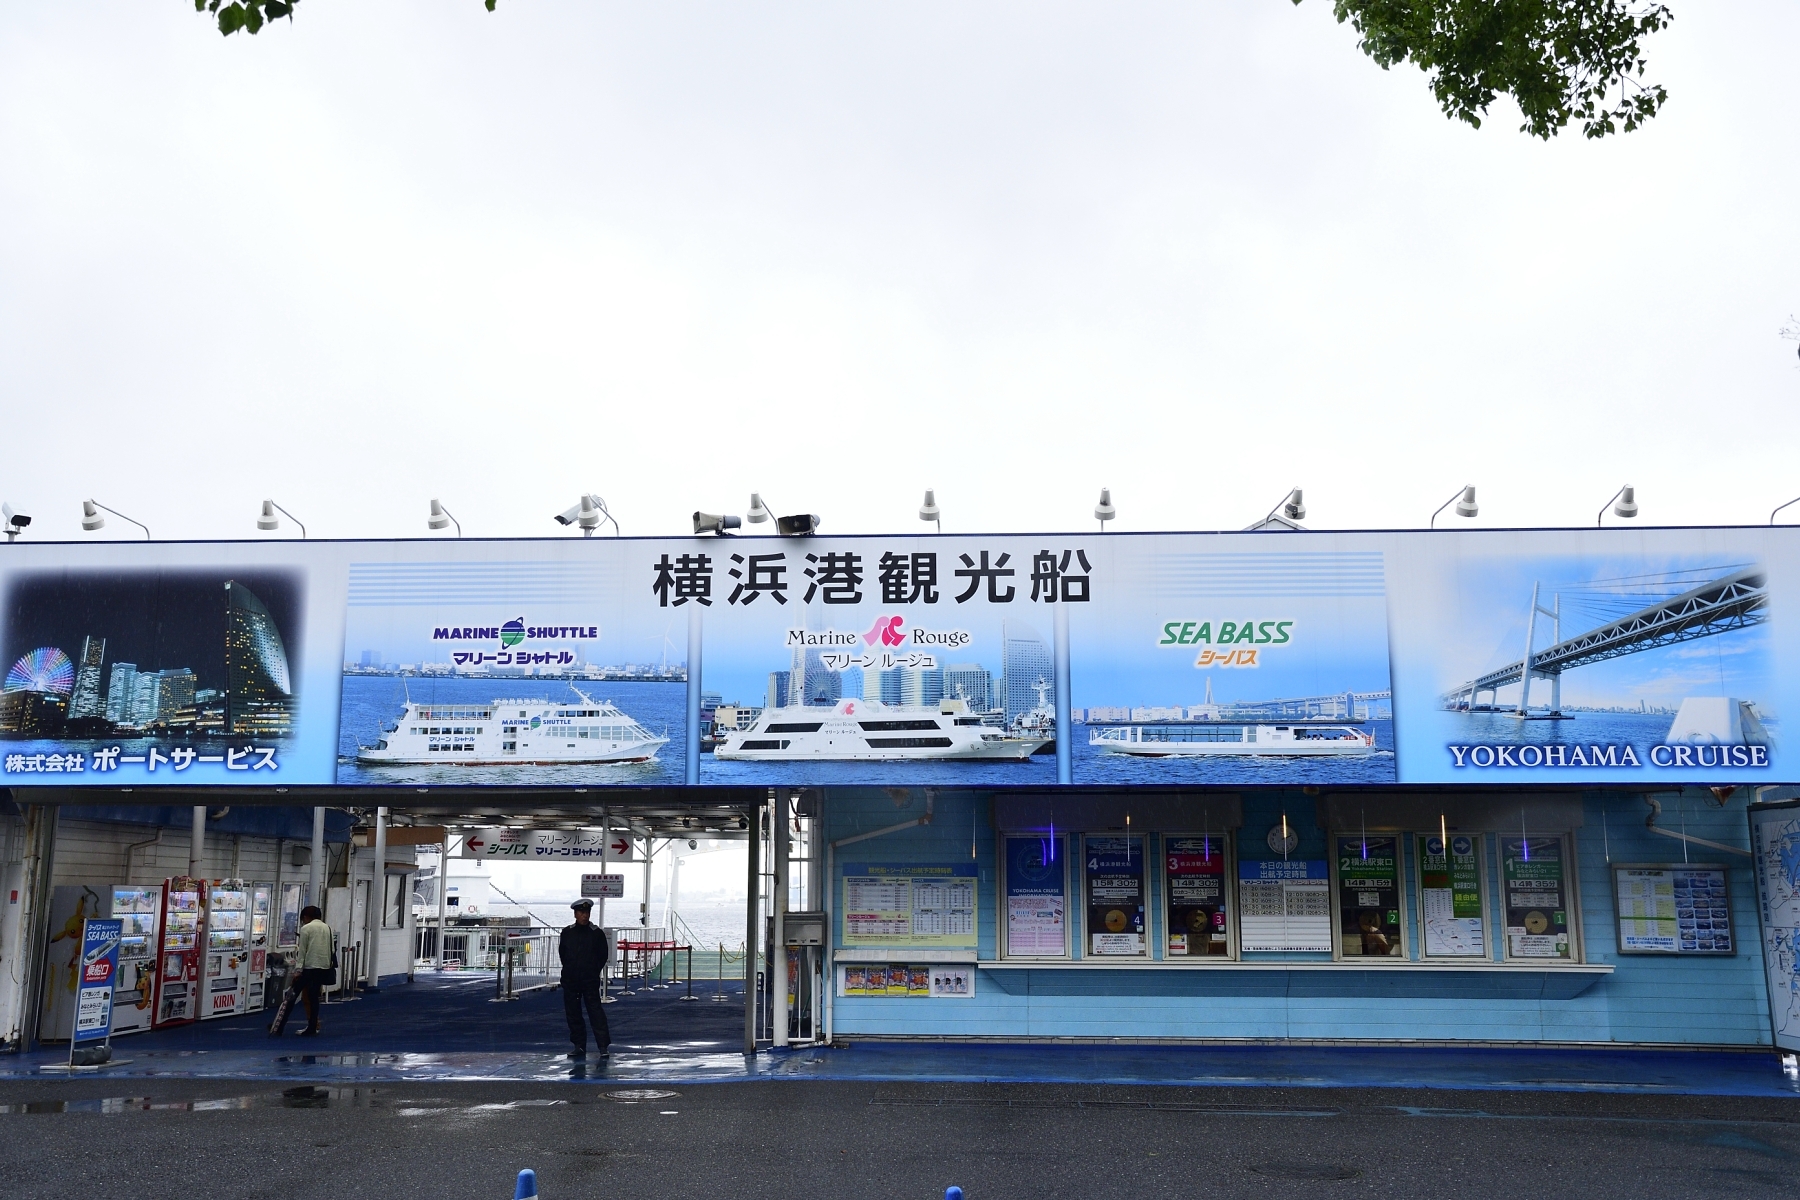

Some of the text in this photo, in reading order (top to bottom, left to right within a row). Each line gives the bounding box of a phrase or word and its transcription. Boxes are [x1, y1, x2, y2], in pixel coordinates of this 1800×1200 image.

[653, 549, 1092, 607] 横浜港観光船
[433, 627, 597, 639] MARINE SHUTTLE
[787, 629, 970, 647] Marine Rouge
[1160, 621, 1293, 644] SEA BASS
[453, 652, 573, 665] マリーン シャトル
[823, 653, 934, 669] マリーン ルージュ
[1198, 650, 1257, 665] シーバス
[5, 745, 278, 773] 株式会社 ポートサービス
[1449, 745, 1768, 767] YOKOHAMA CRUISE
[538, 835, 571, 846] マリーン
[487, 844, 528, 855] シーバス
[536, 847, 570, 856] マリーン
[1088, 858, 1098, 870] 4
[1169, 858, 1178, 870] 3
[1341, 858, 1351, 871] 2
[1506, 858, 1514, 871] 1
[1134, 916, 1140, 924] 4
[1216, 916, 1221, 924] 3
[1390, 914, 1396, 923] 2
[87, 931, 118, 941] SEA BASS
[86, 964, 109, 976] 乗船口
[213, 994, 236, 1008] KIRIN
